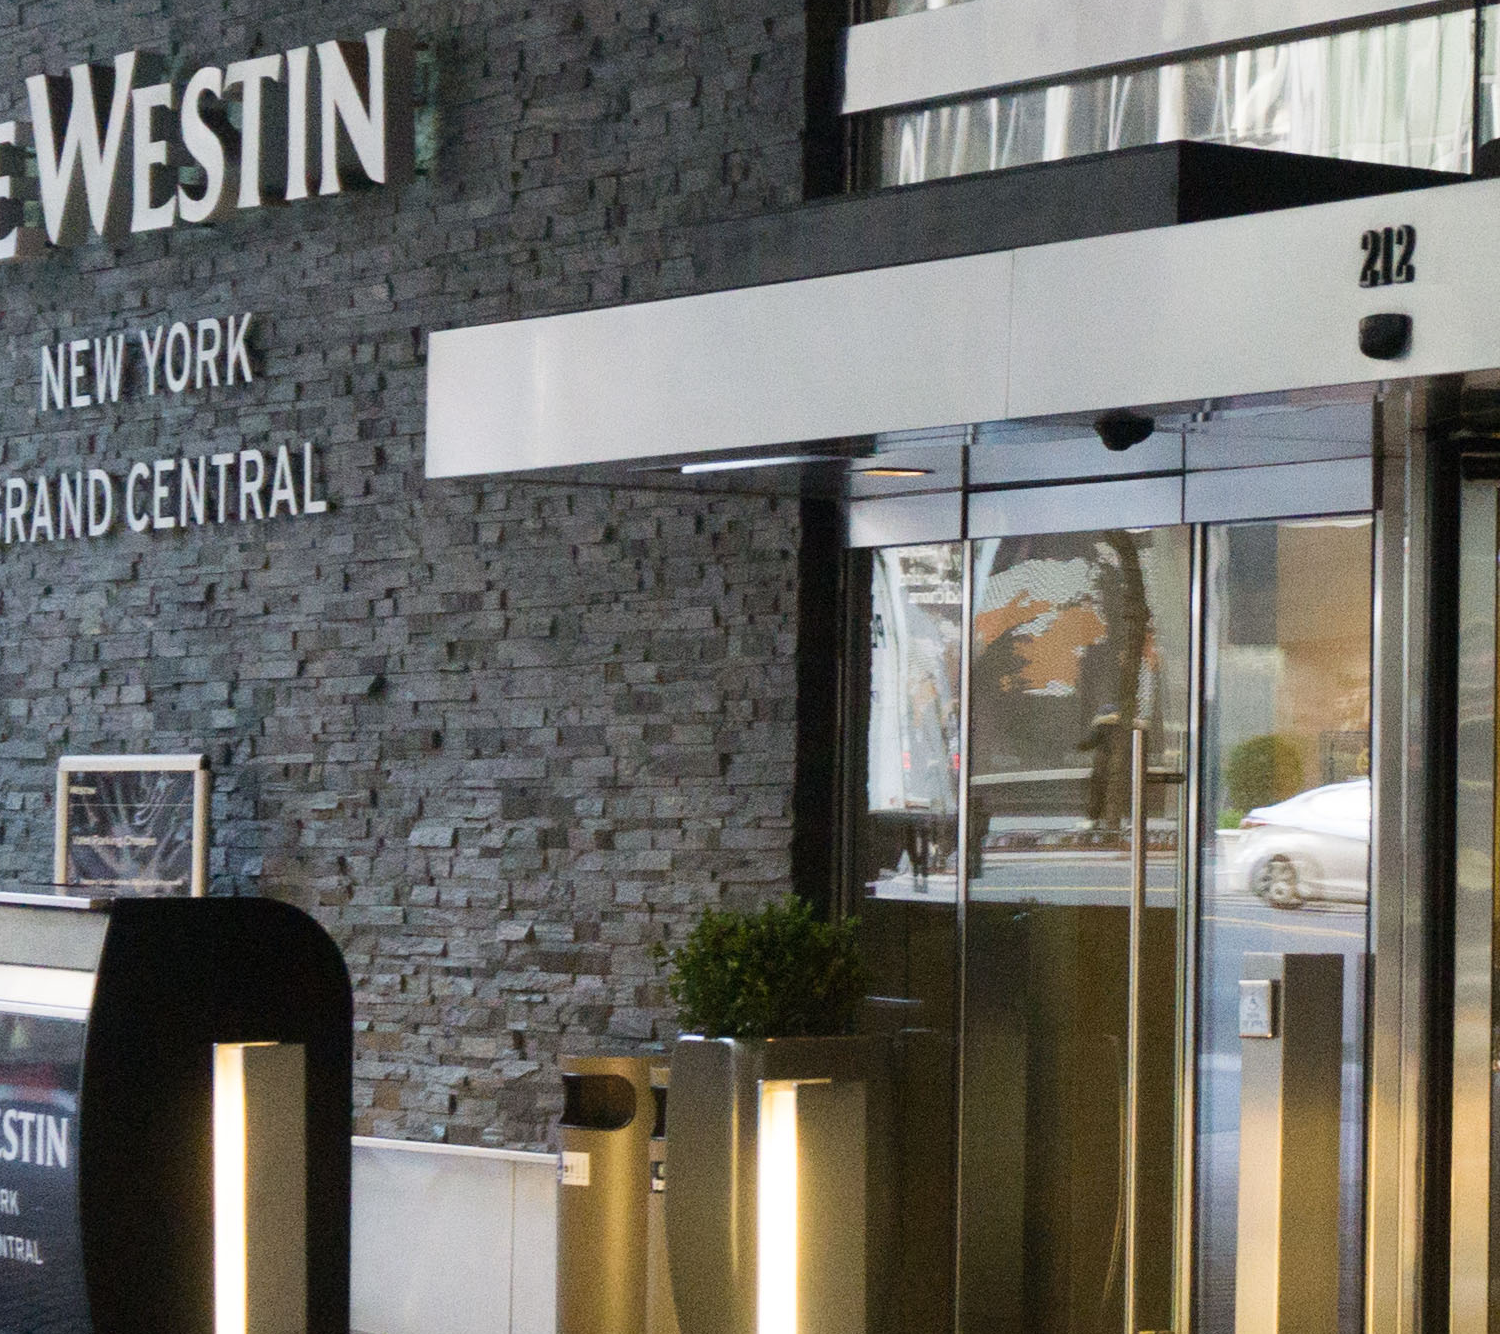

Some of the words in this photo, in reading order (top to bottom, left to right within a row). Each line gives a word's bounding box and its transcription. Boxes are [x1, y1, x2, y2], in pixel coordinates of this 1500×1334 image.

[26, 27, 388, 246] WESTIN
[1359, 224, 1417, 288] 212
[40, 334, 125, 411] NEW
[140, 311, 254, 396] YORK
[126, 441, 328, 533] CENTRAL
